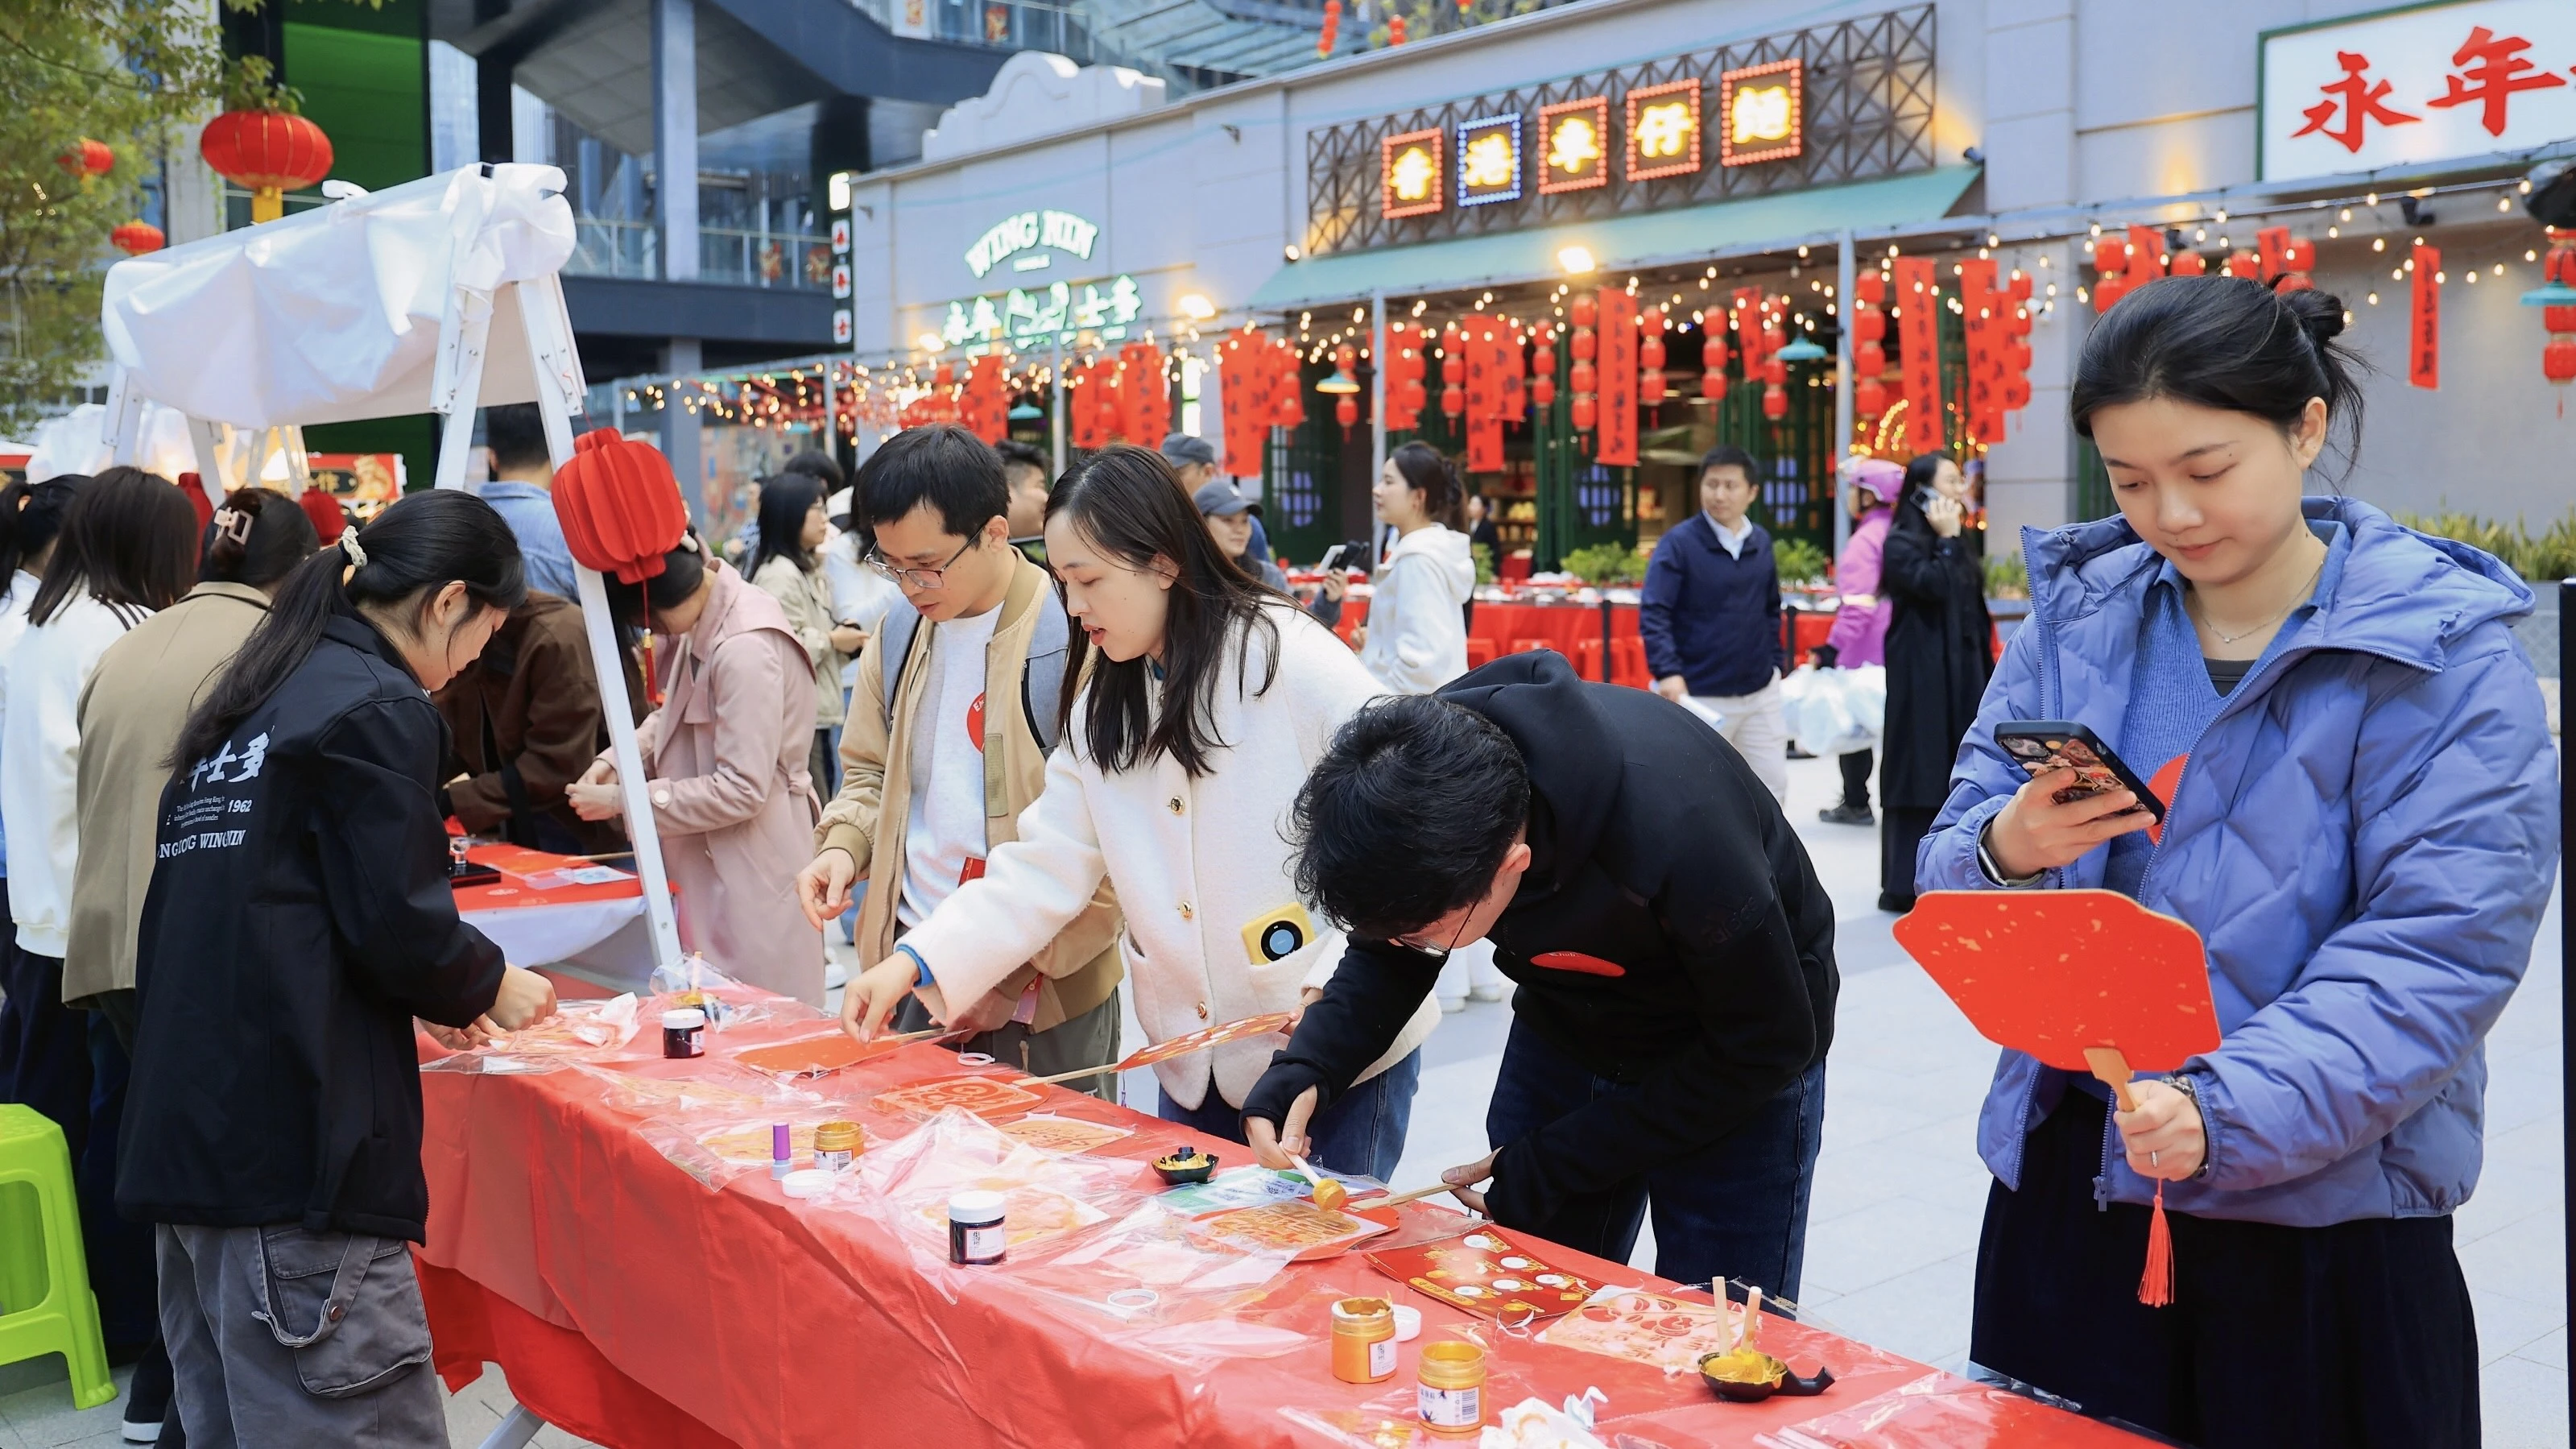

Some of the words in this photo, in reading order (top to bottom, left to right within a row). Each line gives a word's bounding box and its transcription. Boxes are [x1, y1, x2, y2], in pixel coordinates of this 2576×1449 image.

[2290, 25, 2576, 153] 永年
[965, 210, 1040, 279] WING
[227, 799, 252, 814] 1962
